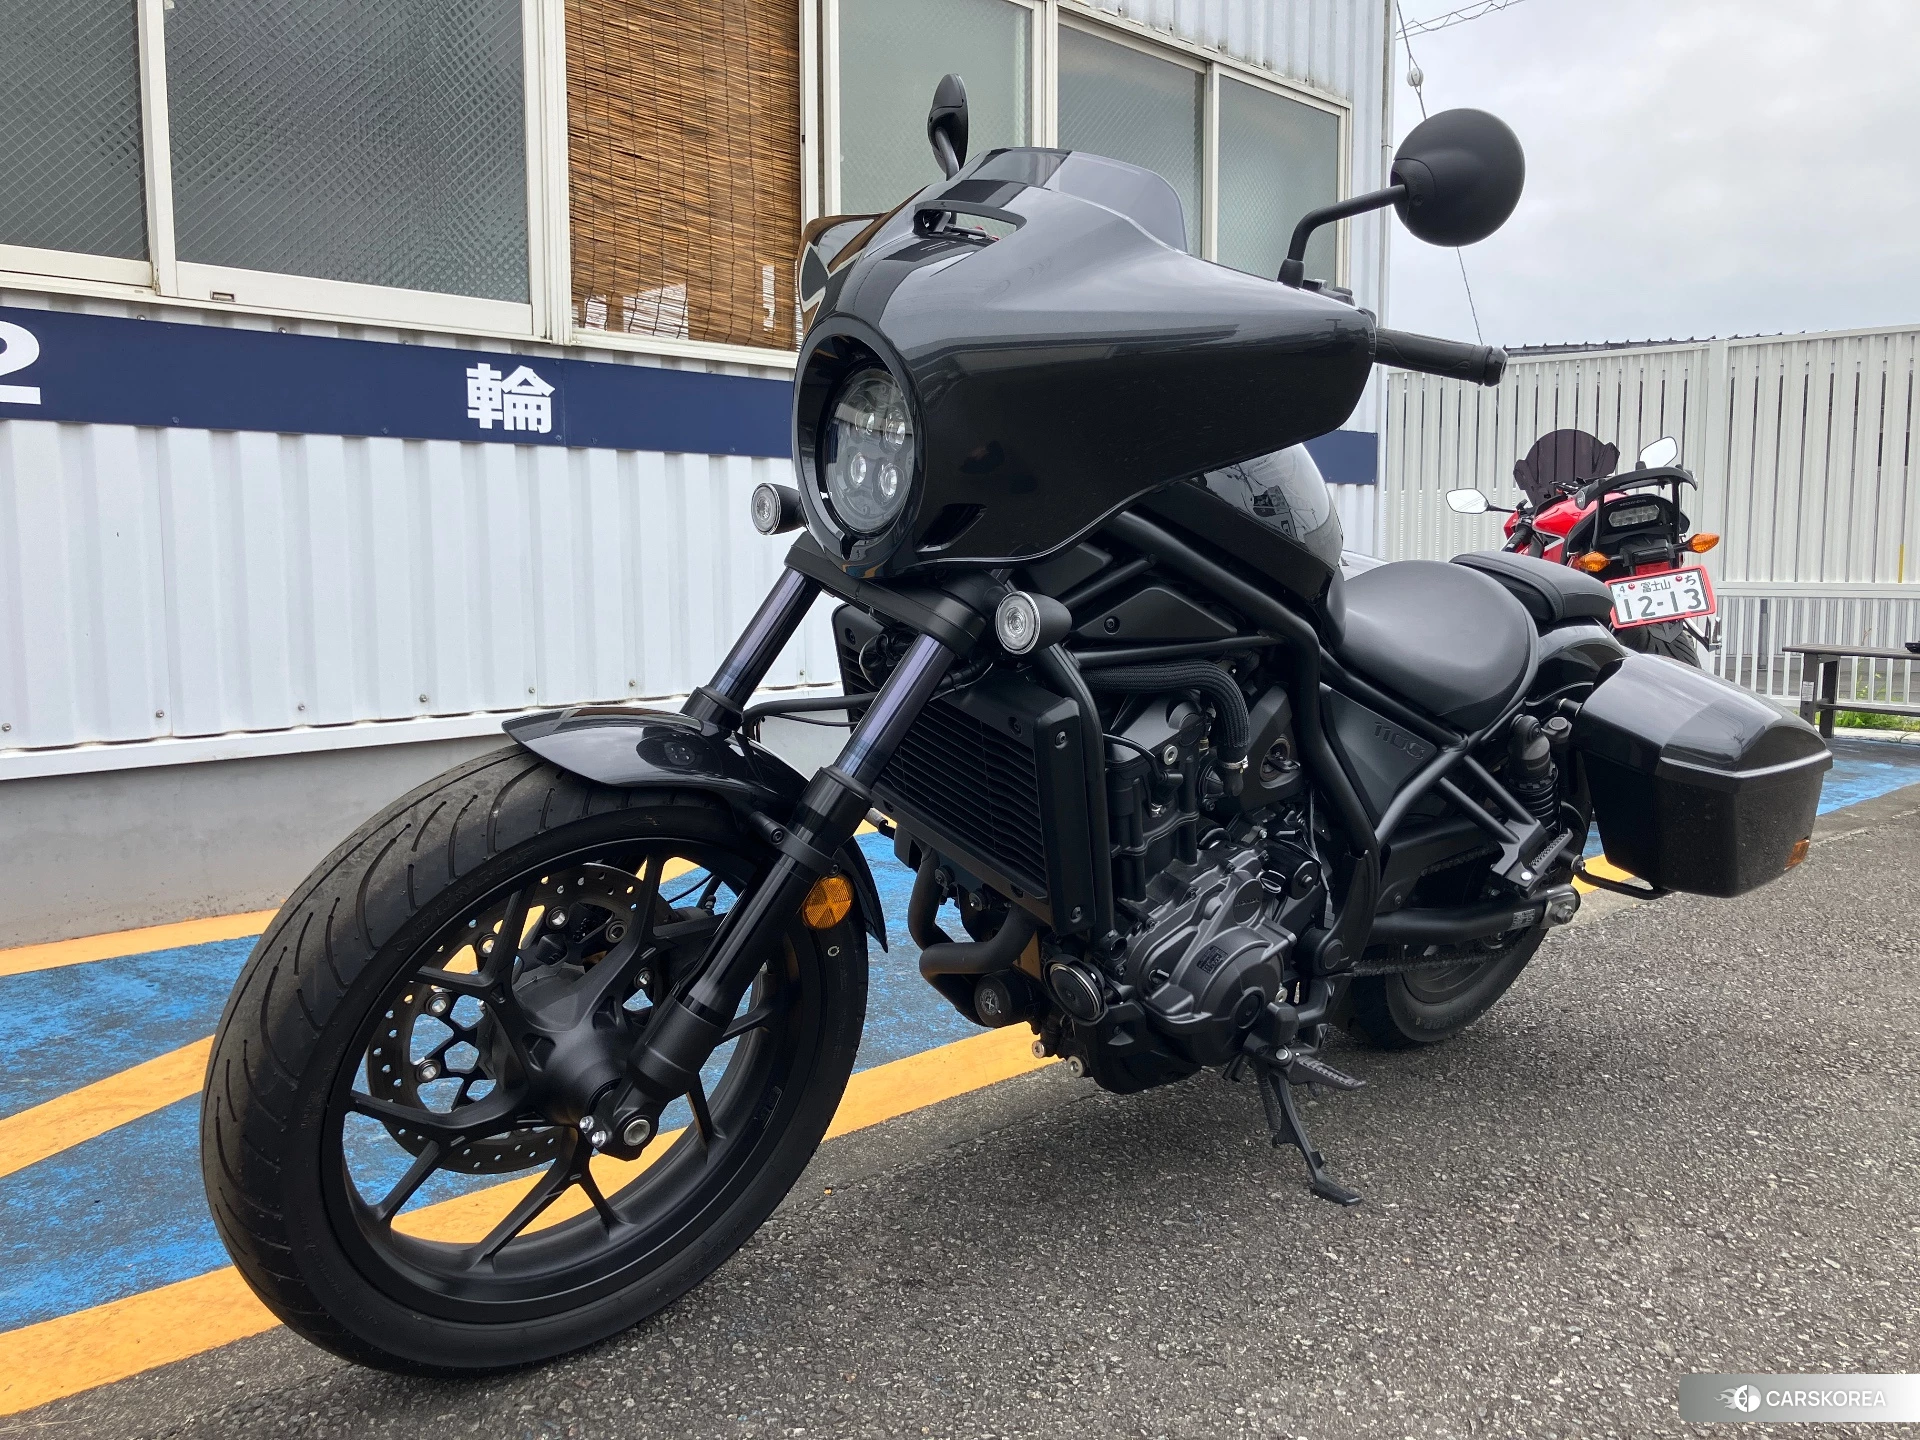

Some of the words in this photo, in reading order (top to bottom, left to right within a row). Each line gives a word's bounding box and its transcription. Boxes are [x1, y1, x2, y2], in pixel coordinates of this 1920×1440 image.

[466, 363, 556, 434] 輪
[1641, 579, 1671, 593] 富士山
[1684, 574, 1697, 586] ち
[1624, 588, 1702, 620] 12-13
